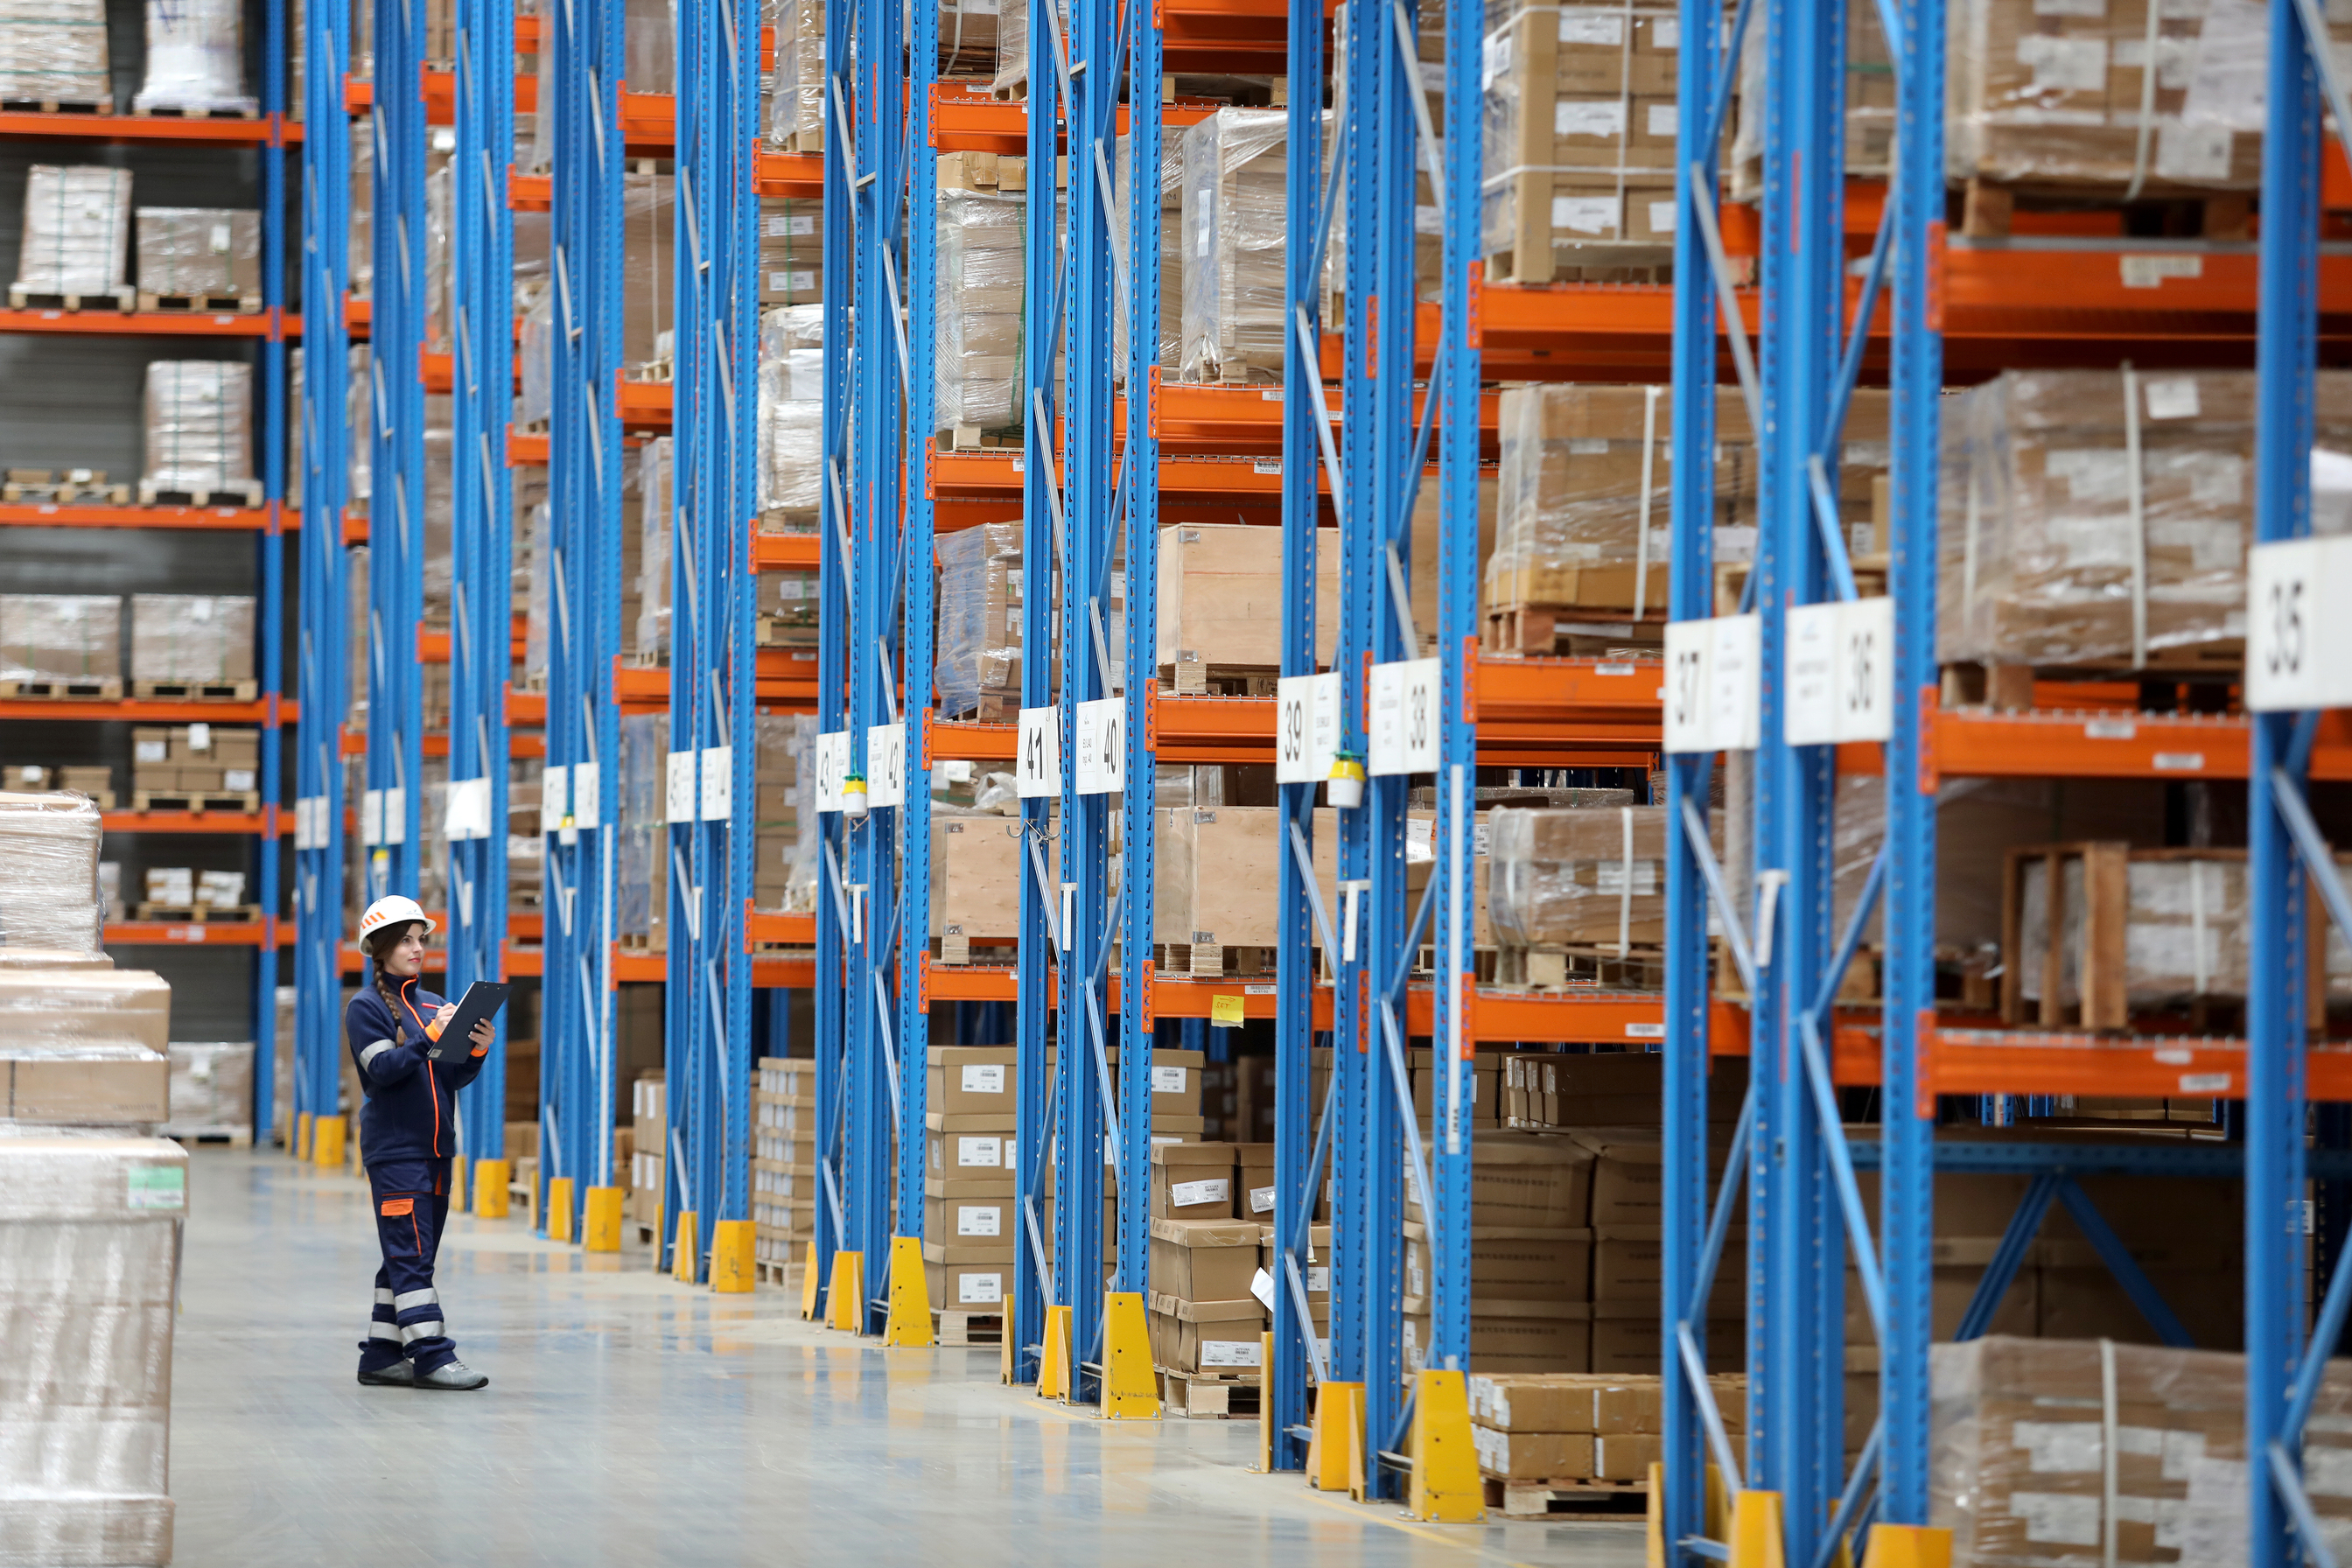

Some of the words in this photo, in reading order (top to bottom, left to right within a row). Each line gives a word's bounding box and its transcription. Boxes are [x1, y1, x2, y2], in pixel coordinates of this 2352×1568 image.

[1166, 192, 1177, 201] D4
[2266, 581, 2304, 677] 35
[1675, 650, 1700, 724] 37
[1848, 631, 1875, 711] 36
[1103, 718, 1116, 774] 40
[1284, 700, 1303, 762] 39
[1410, 684, 1428, 750] 38
[819, 751, 830, 796] 43
[888, 741, 899, 789] 42
[1026, 727, 1043, 780] 41
